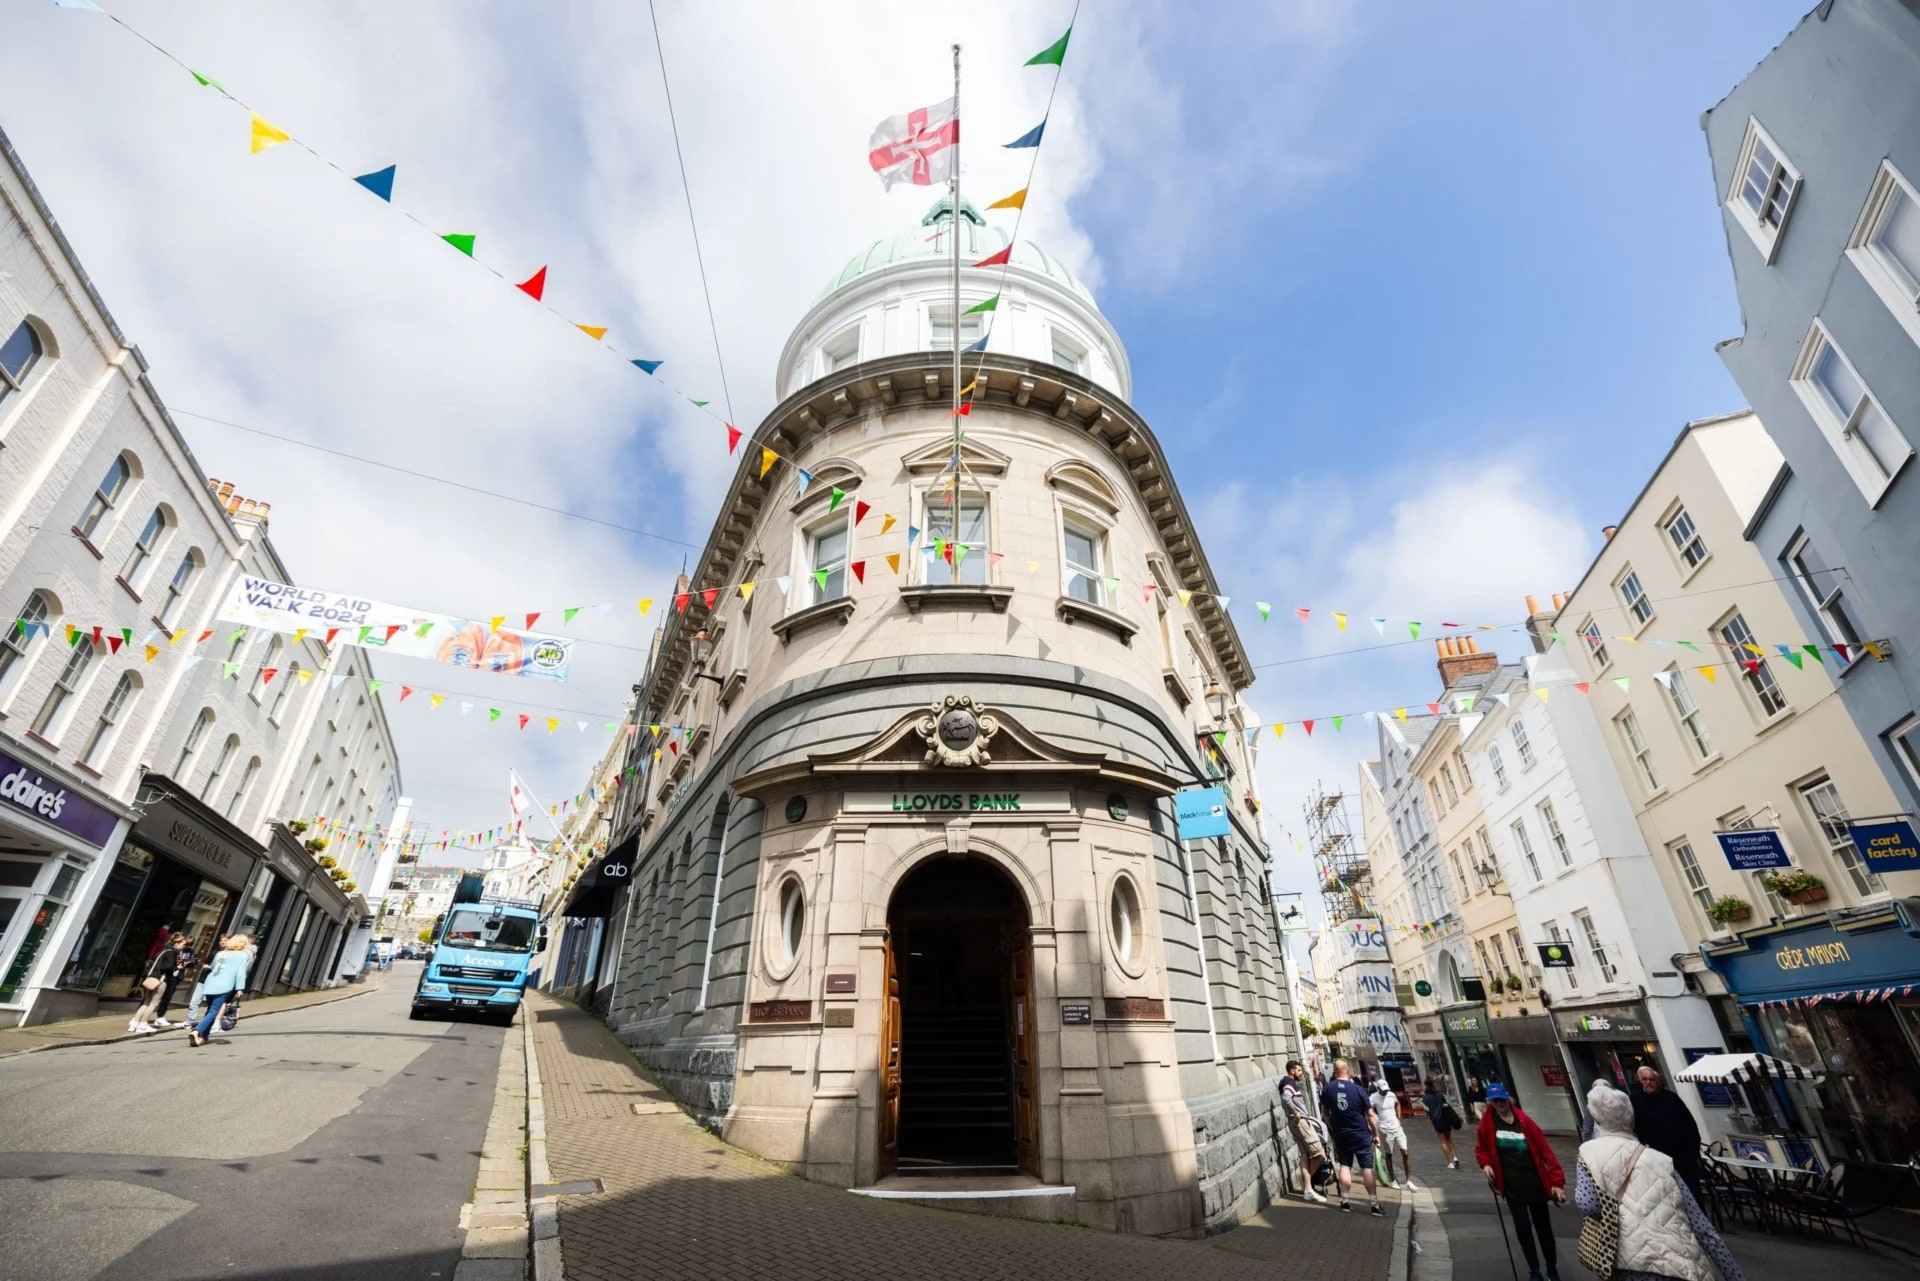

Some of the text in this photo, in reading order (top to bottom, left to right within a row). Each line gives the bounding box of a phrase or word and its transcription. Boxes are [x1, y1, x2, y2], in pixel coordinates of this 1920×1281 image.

[244, 578, 373, 613] WORLD AID
[308, 605, 367, 625] 2024
[892, 793, 1022, 811] LLOYDS BANK
[1727, 834, 1771, 844] Roseneath
[1870, 832, 1902, 847] card
[1732, 844, 1774, 852] Orthodontics
[1866, 846, 1918, 860] factory
[1734, 851, 1779, 862] Roseneath
[603, 861, 628, 877] ab
[462, 953, 505, 967] Access
[1587, 1015, 1611, 1031] millets
[1336, 1092, 1349, 1111] 5
